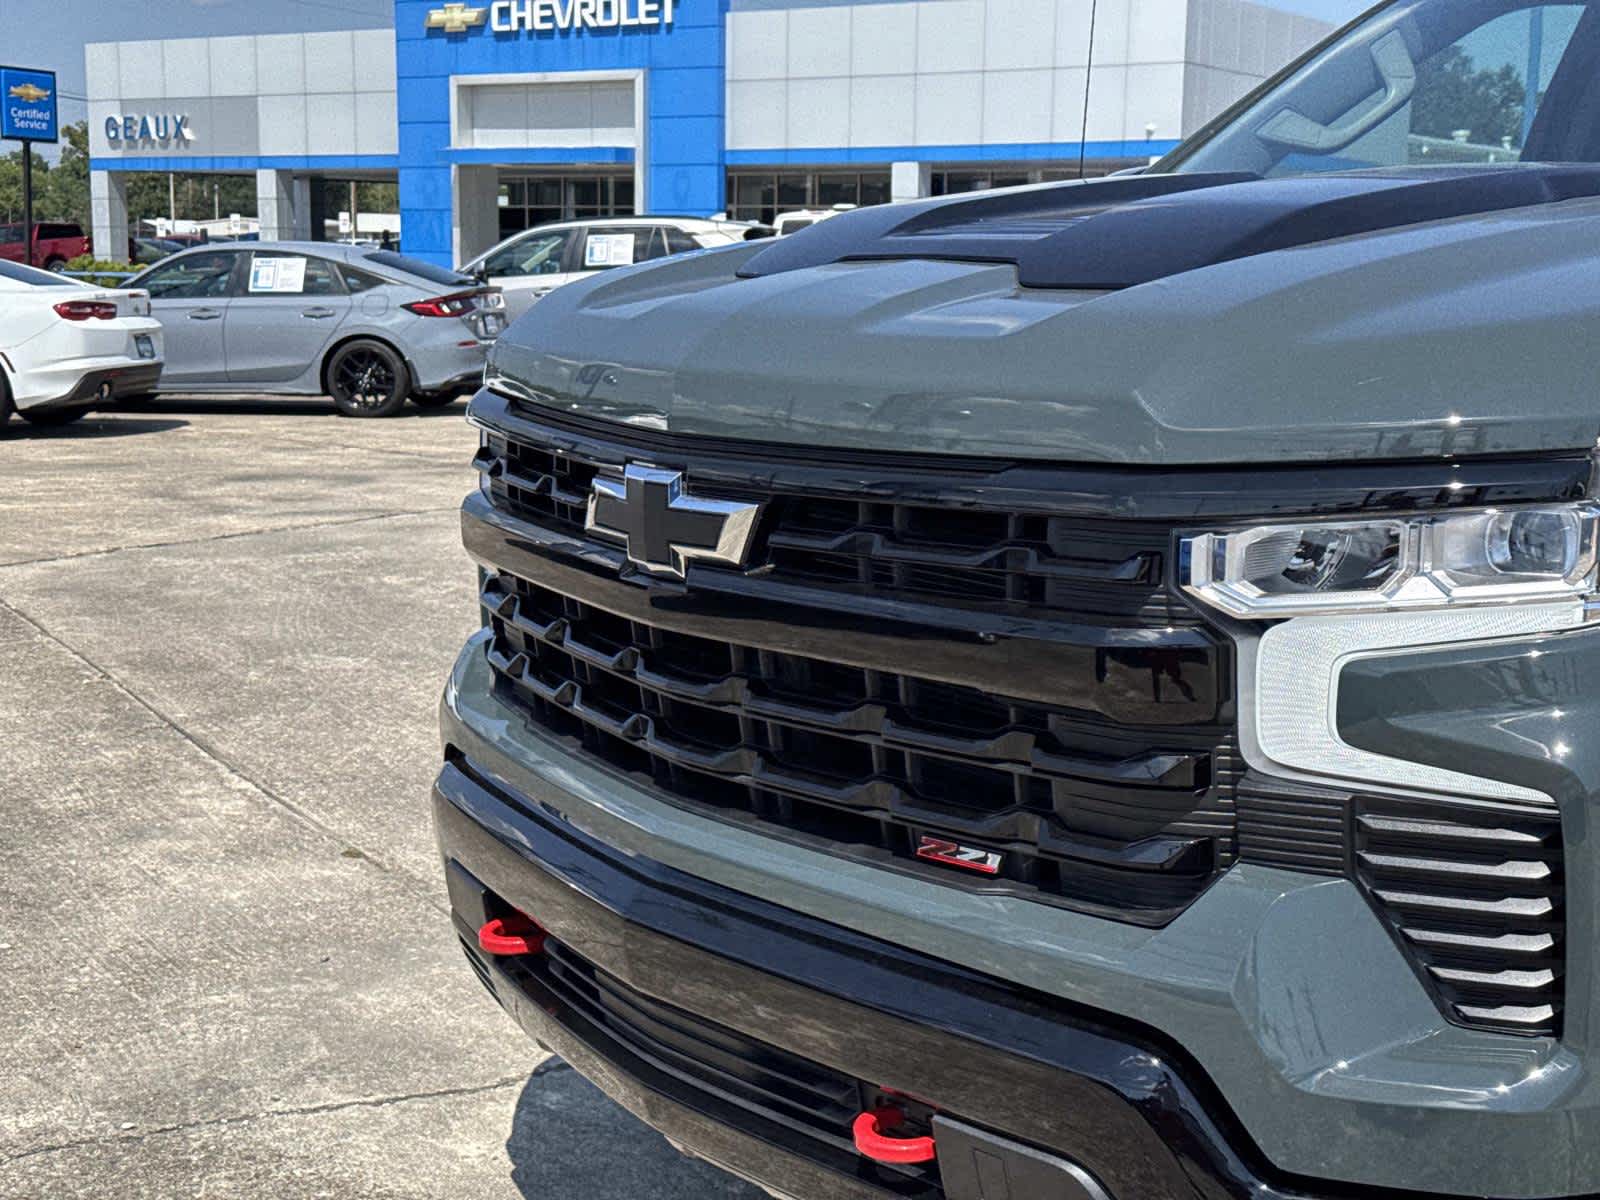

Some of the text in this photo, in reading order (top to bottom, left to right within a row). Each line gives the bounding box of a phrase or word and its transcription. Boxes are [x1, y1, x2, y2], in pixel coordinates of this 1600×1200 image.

[10, 107, 51, 121] Certified
[14, 118, 49, 131] Service
[105, 115, 187, 140] GEAUX
[916, 836, 1003, 875] Z71
